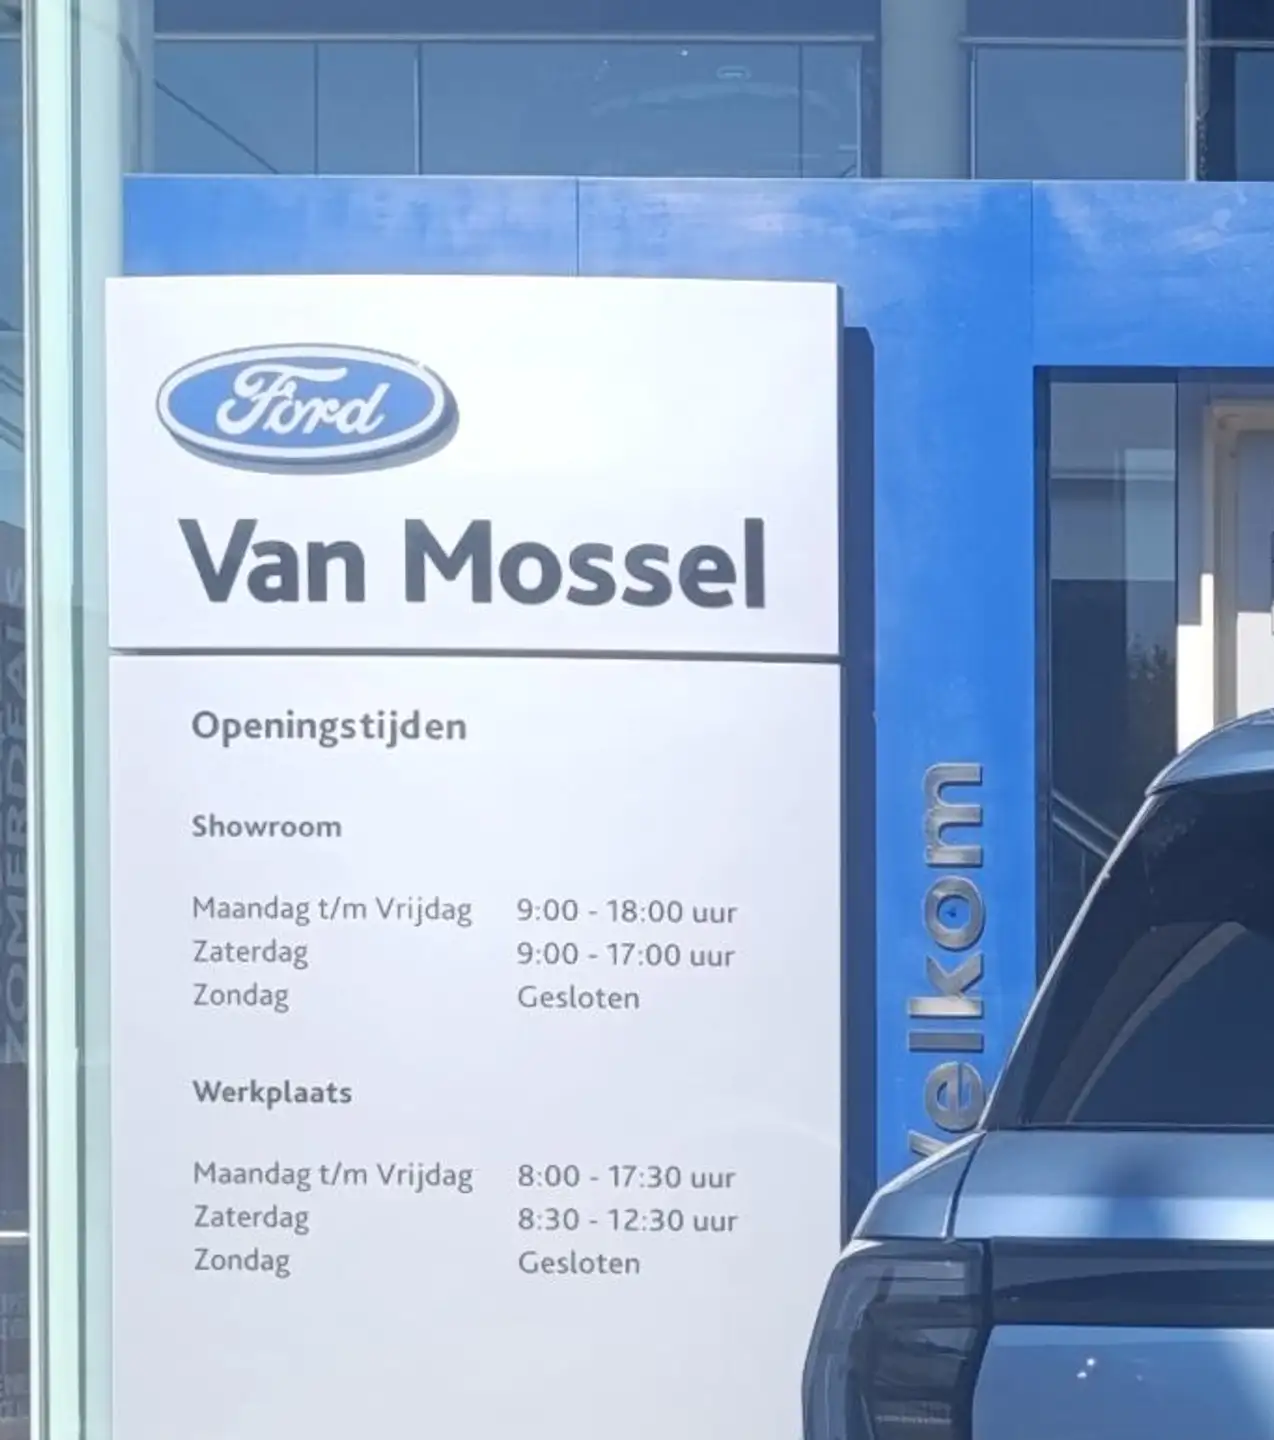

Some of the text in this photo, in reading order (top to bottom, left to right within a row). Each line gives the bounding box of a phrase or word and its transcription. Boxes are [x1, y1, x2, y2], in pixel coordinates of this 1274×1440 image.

[214, 363, 390, 437] Ford
[178, 517, 766, 610] Van Mossel
[191, 709, 467, 749] Openingstijden
[192, 812, 342, 838] Showroom
[193, 895, 472, 929] Maandag t/m Vrijdag
[517, 898, 578, 922] 9:00
[607, 899, 683, 924] 18:00
[693, 905, 738, 925] uur
[193, 938, 308, 971] Zaterdag
[517, 942, 579, 966] 9:00
[607, 943, 681, 967] 17:00
[690, 948, 736, 968] uur
[193, 982, 289, 1014] Zondag
[518, 984, 640, 1010] Gesloten
[192, 1079, 352, 1110] Werkplaats
[194, 1160, 473, 1194] Maandag t/m Vrijdag
[518, 1164, 580, 1188] 8:00
[609, 1165, 681, 1189] 17:30
[691, 1171, 736, 1190] uur
[194, 1204, 309, 1237] Zaterdag
[518, 1207, 579, 1231] 8:30
[608, 1208, 684, 1232] 12:30
[693, 1214, 739, 1233] uur
[194, 1247, 291, 1280] Zondag
[519, 1249, 640, 1275] Gesloten
